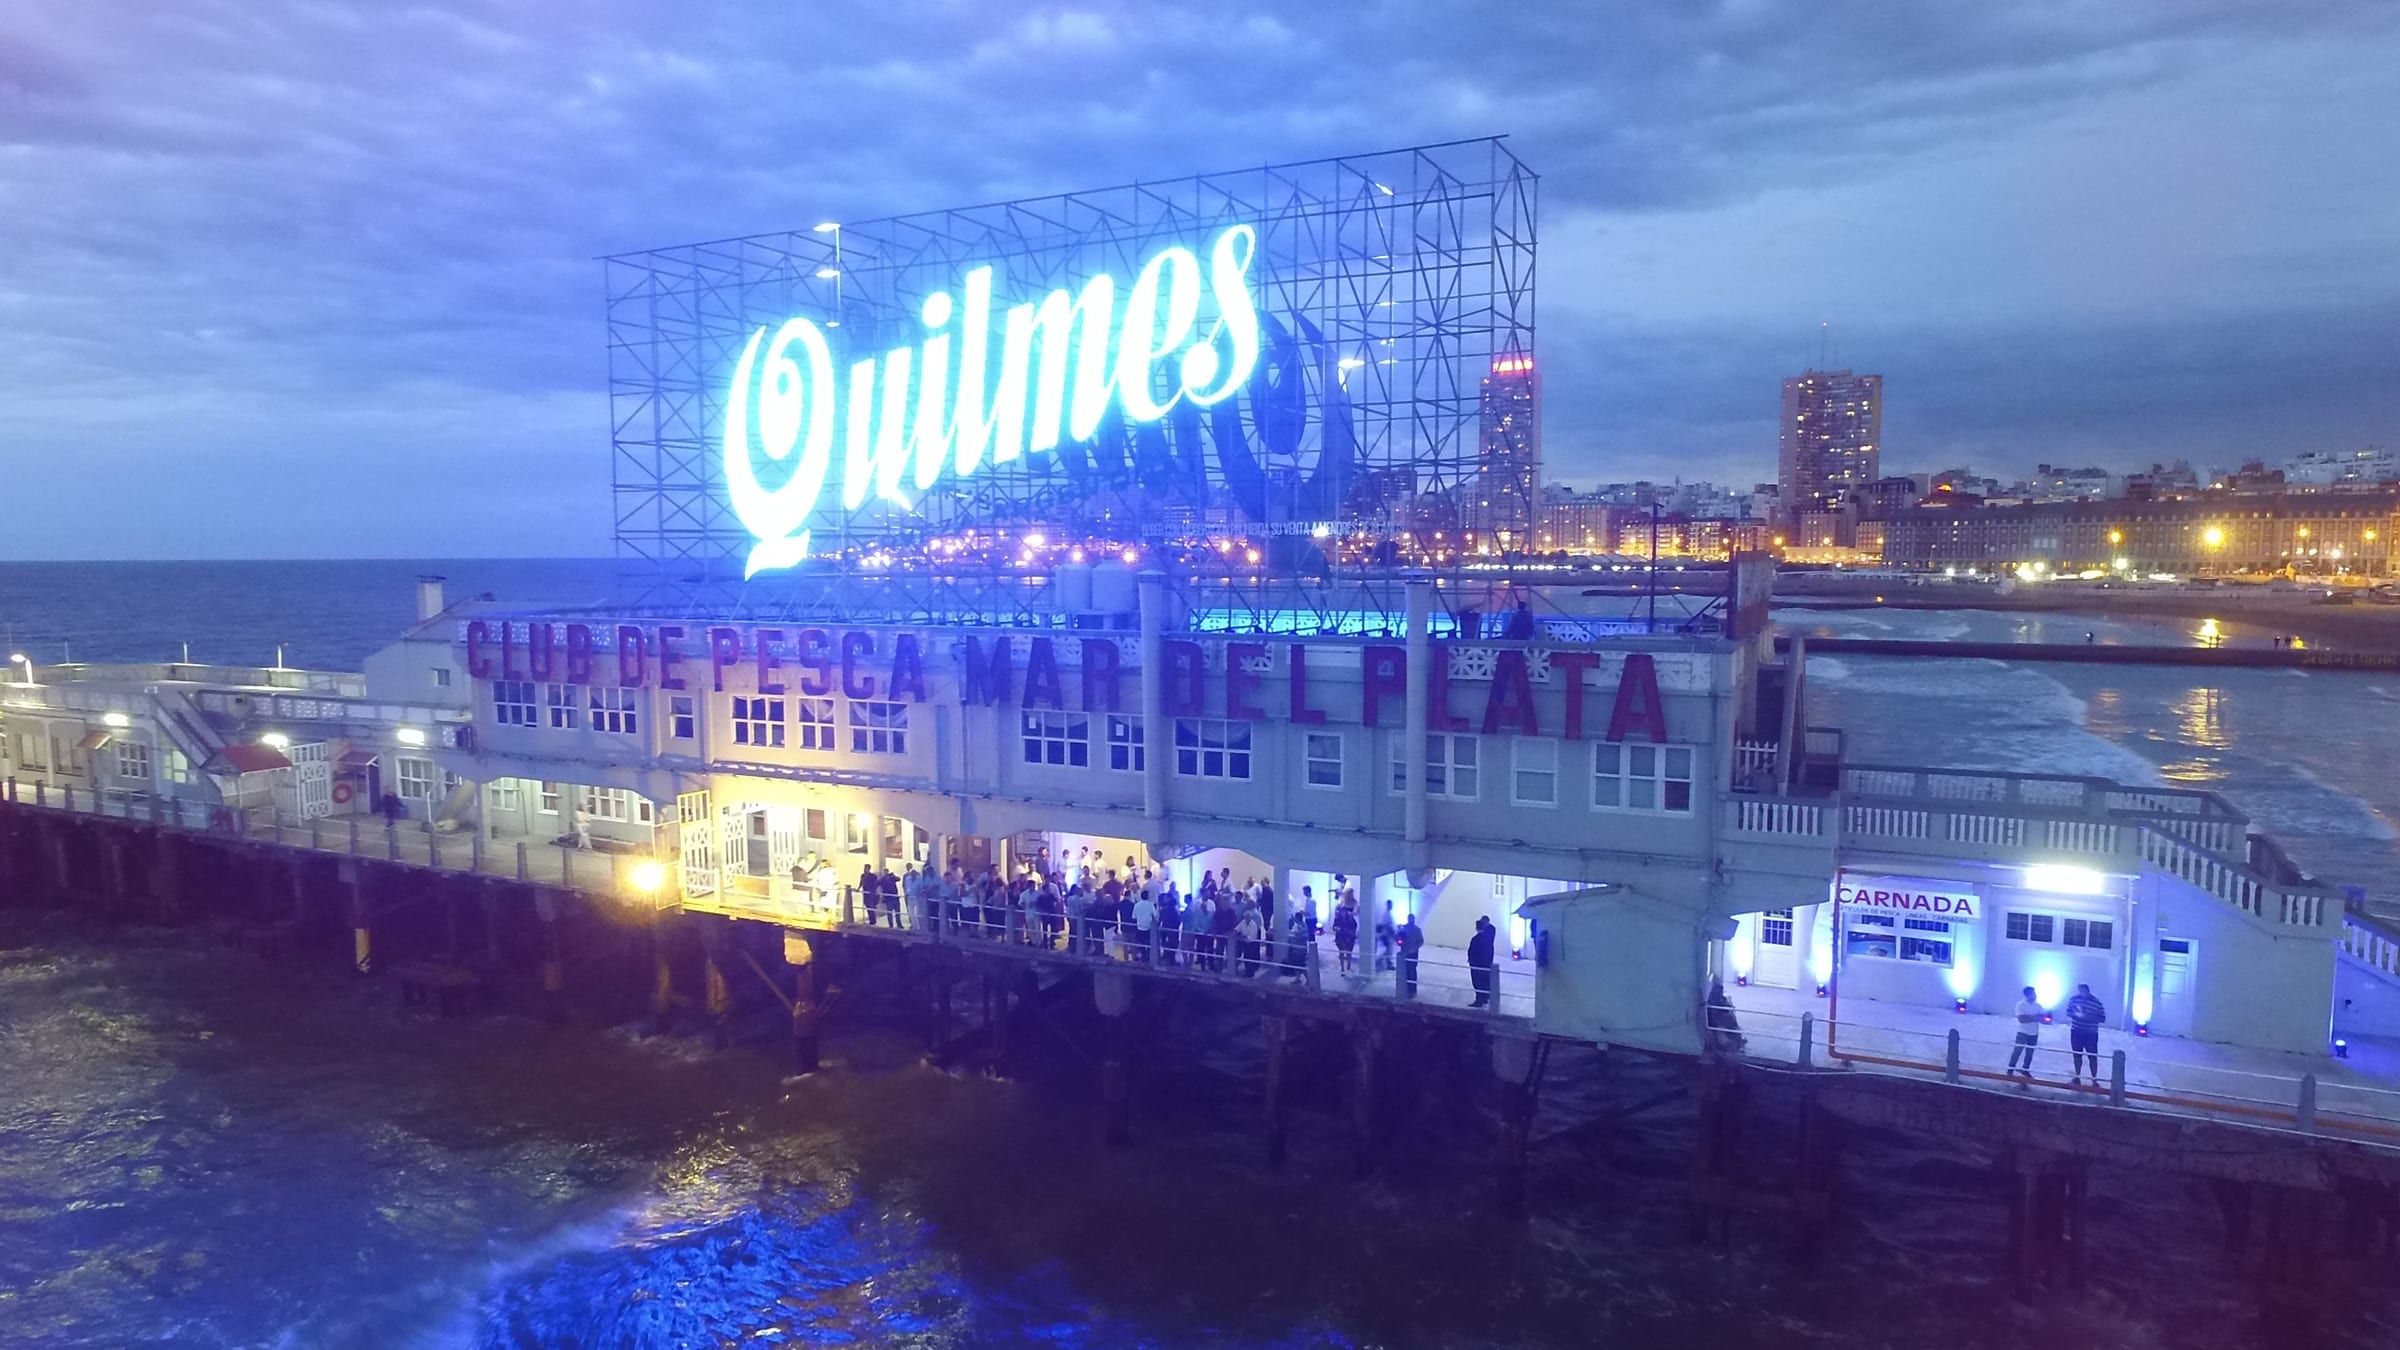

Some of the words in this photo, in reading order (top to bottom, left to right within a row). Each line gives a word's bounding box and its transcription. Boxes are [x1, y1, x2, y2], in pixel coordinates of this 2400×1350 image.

[723, 223, 1260, 581] Quilmes
[1271, 522, 1284, 536] SU
[1285, 522, 1309, 535] VENTA
[467, 621, 593, 684] CLUB
[618, 625, 686, 690] DE
[711, 627, 926, 703] PESCA
[966, 632, 1119, 712] MAR
[1162, 640, 1325, 724] DEL
[1363, 644, 1667, 743] PLATA
[1838, 888, 1973, 915] CARNADA
